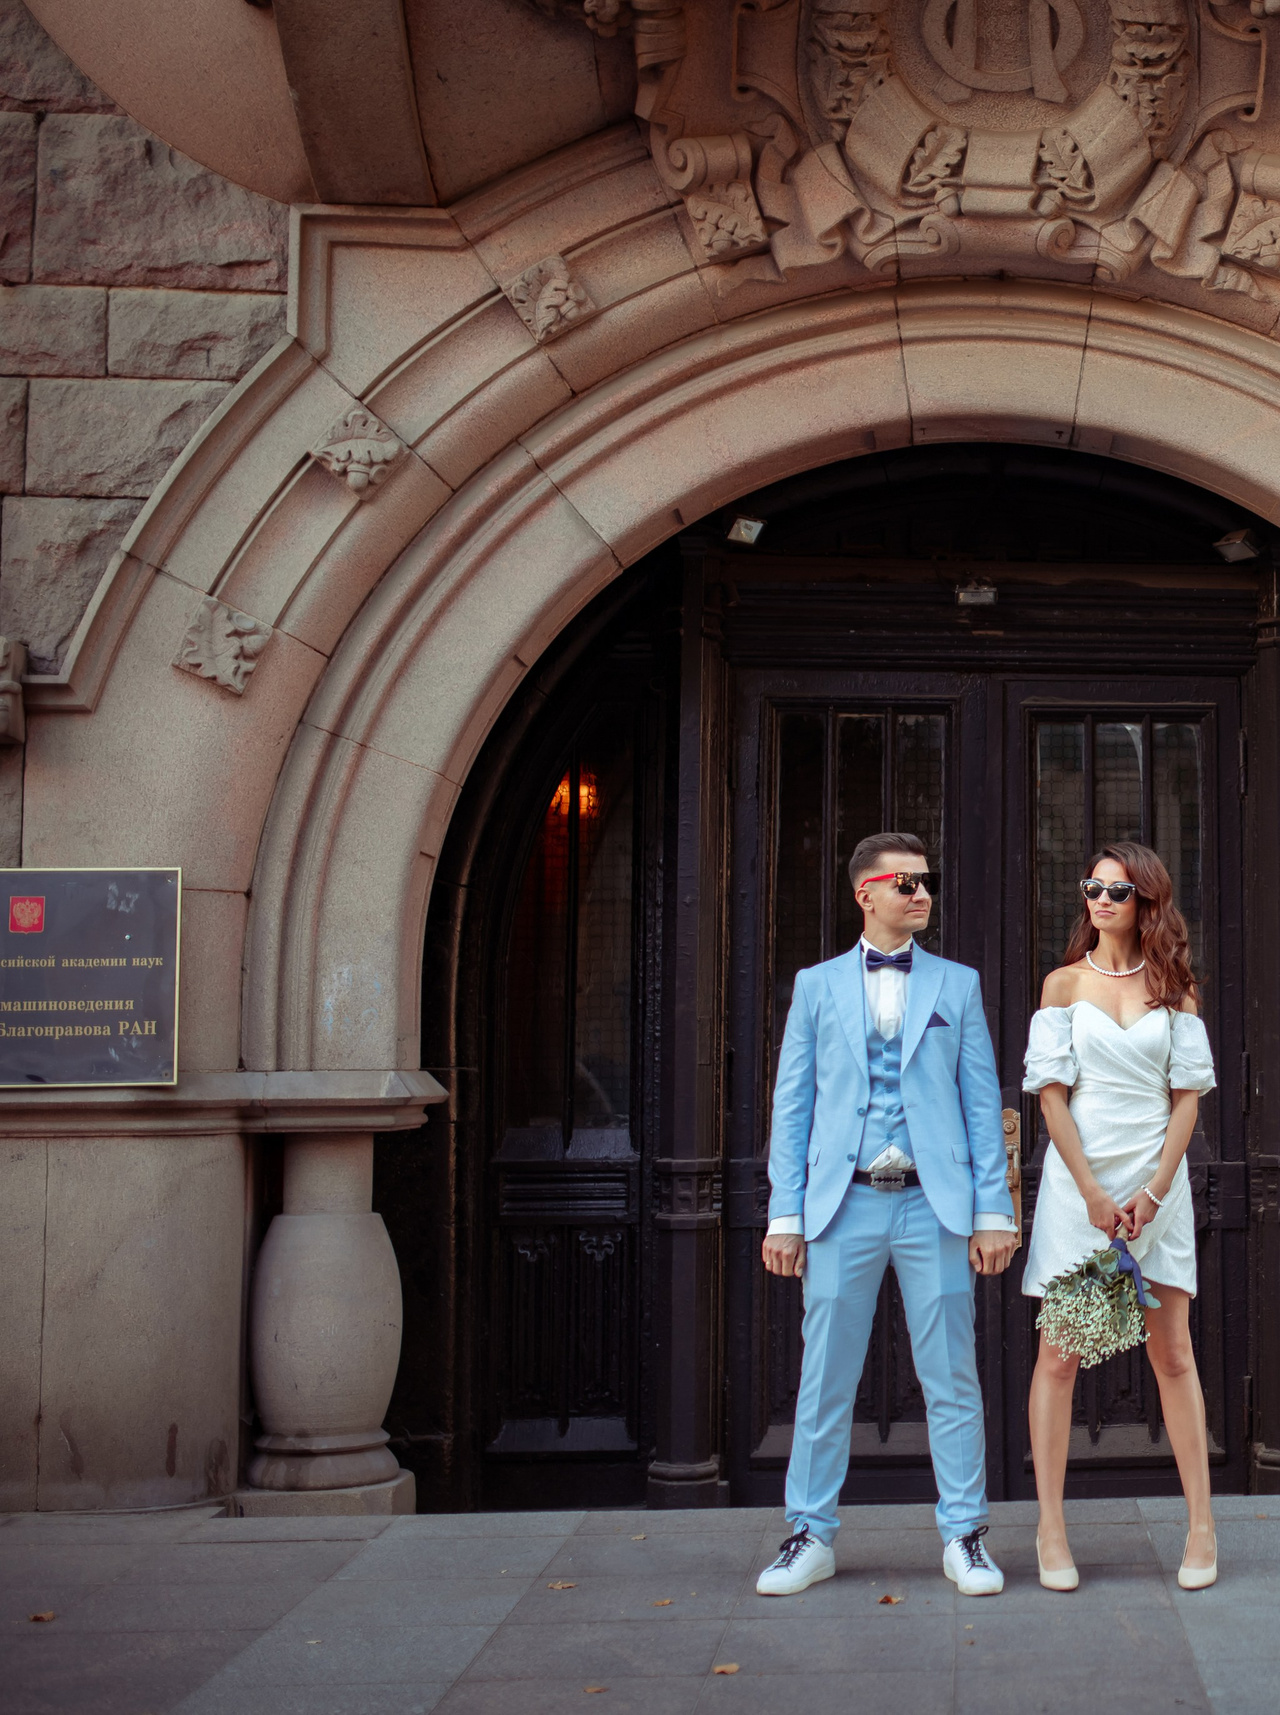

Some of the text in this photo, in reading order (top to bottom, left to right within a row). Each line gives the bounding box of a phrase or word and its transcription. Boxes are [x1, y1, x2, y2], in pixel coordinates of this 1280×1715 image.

[62, 957, 127, 968] академии
[132, 957, 163, 968] наук
[0, 999, 134, 1013] машиноведения
[118, 1020, 157, 1035] РАН
